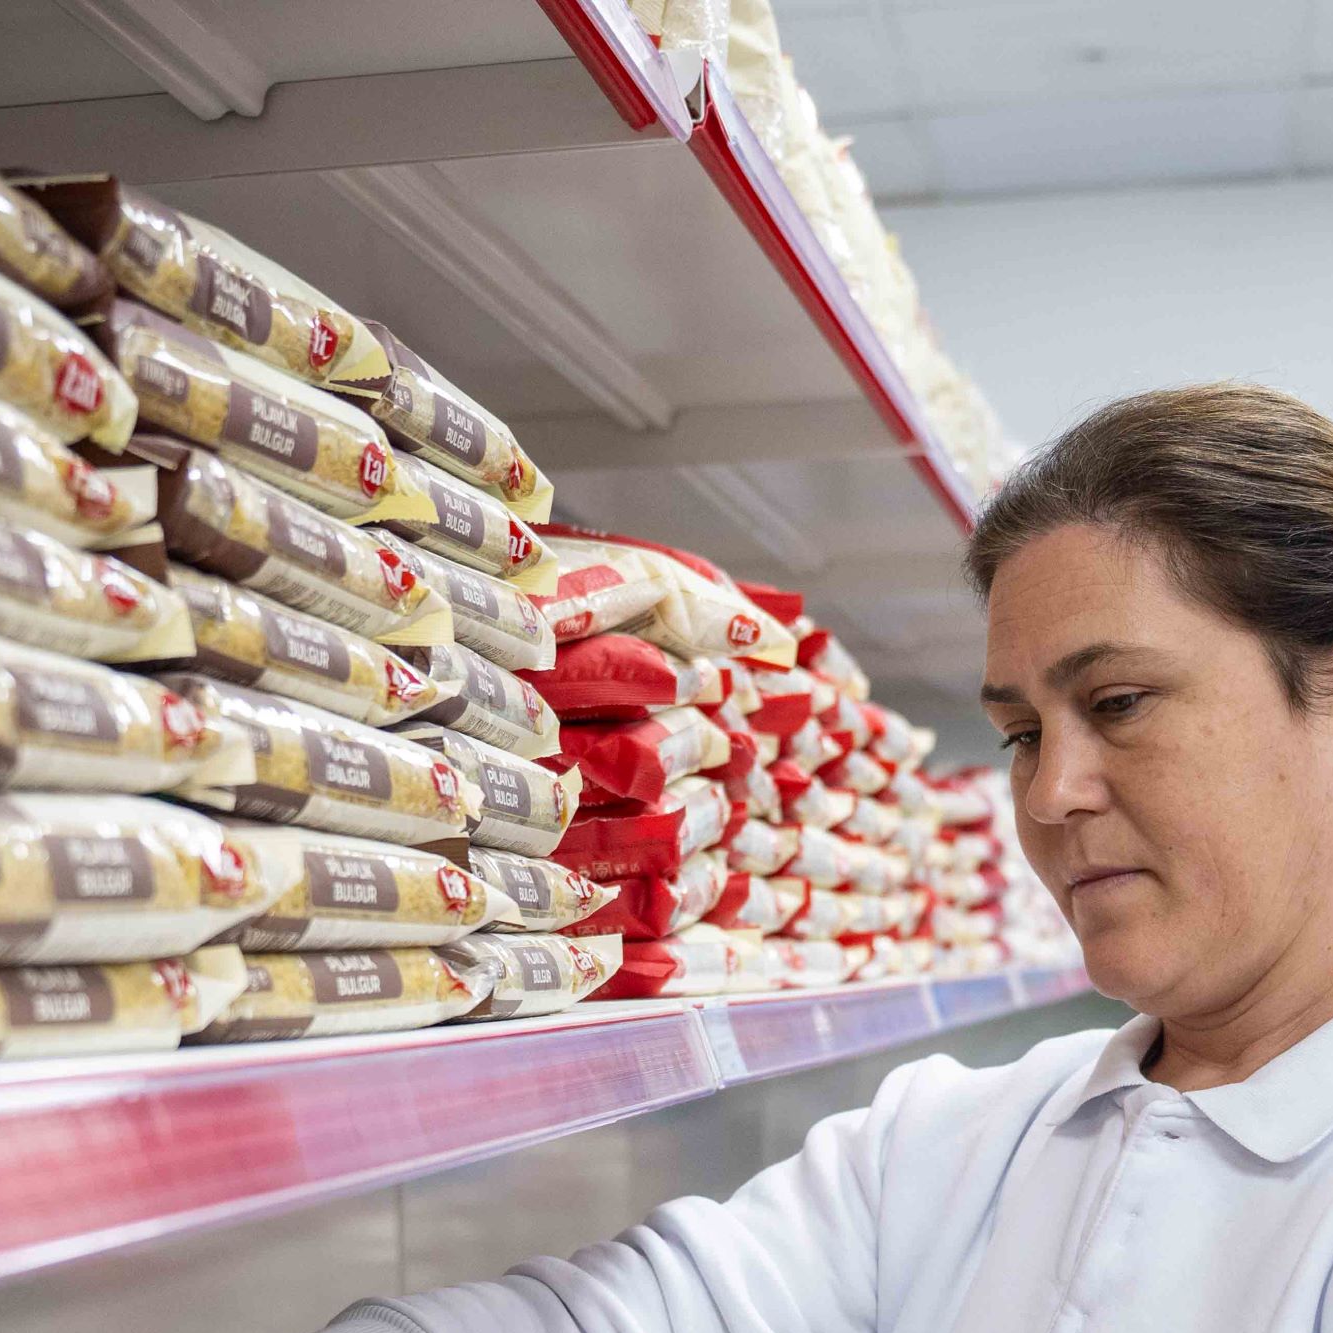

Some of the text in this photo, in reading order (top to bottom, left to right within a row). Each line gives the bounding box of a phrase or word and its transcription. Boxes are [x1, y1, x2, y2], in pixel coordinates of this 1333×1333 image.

[445, 427, 472, 453] BULGUR
[445, 514, 472, 536] BULGUR
[486, 766, 518, 788] PİLAVLIK
[494, 788, 519, 809] BULGUR
